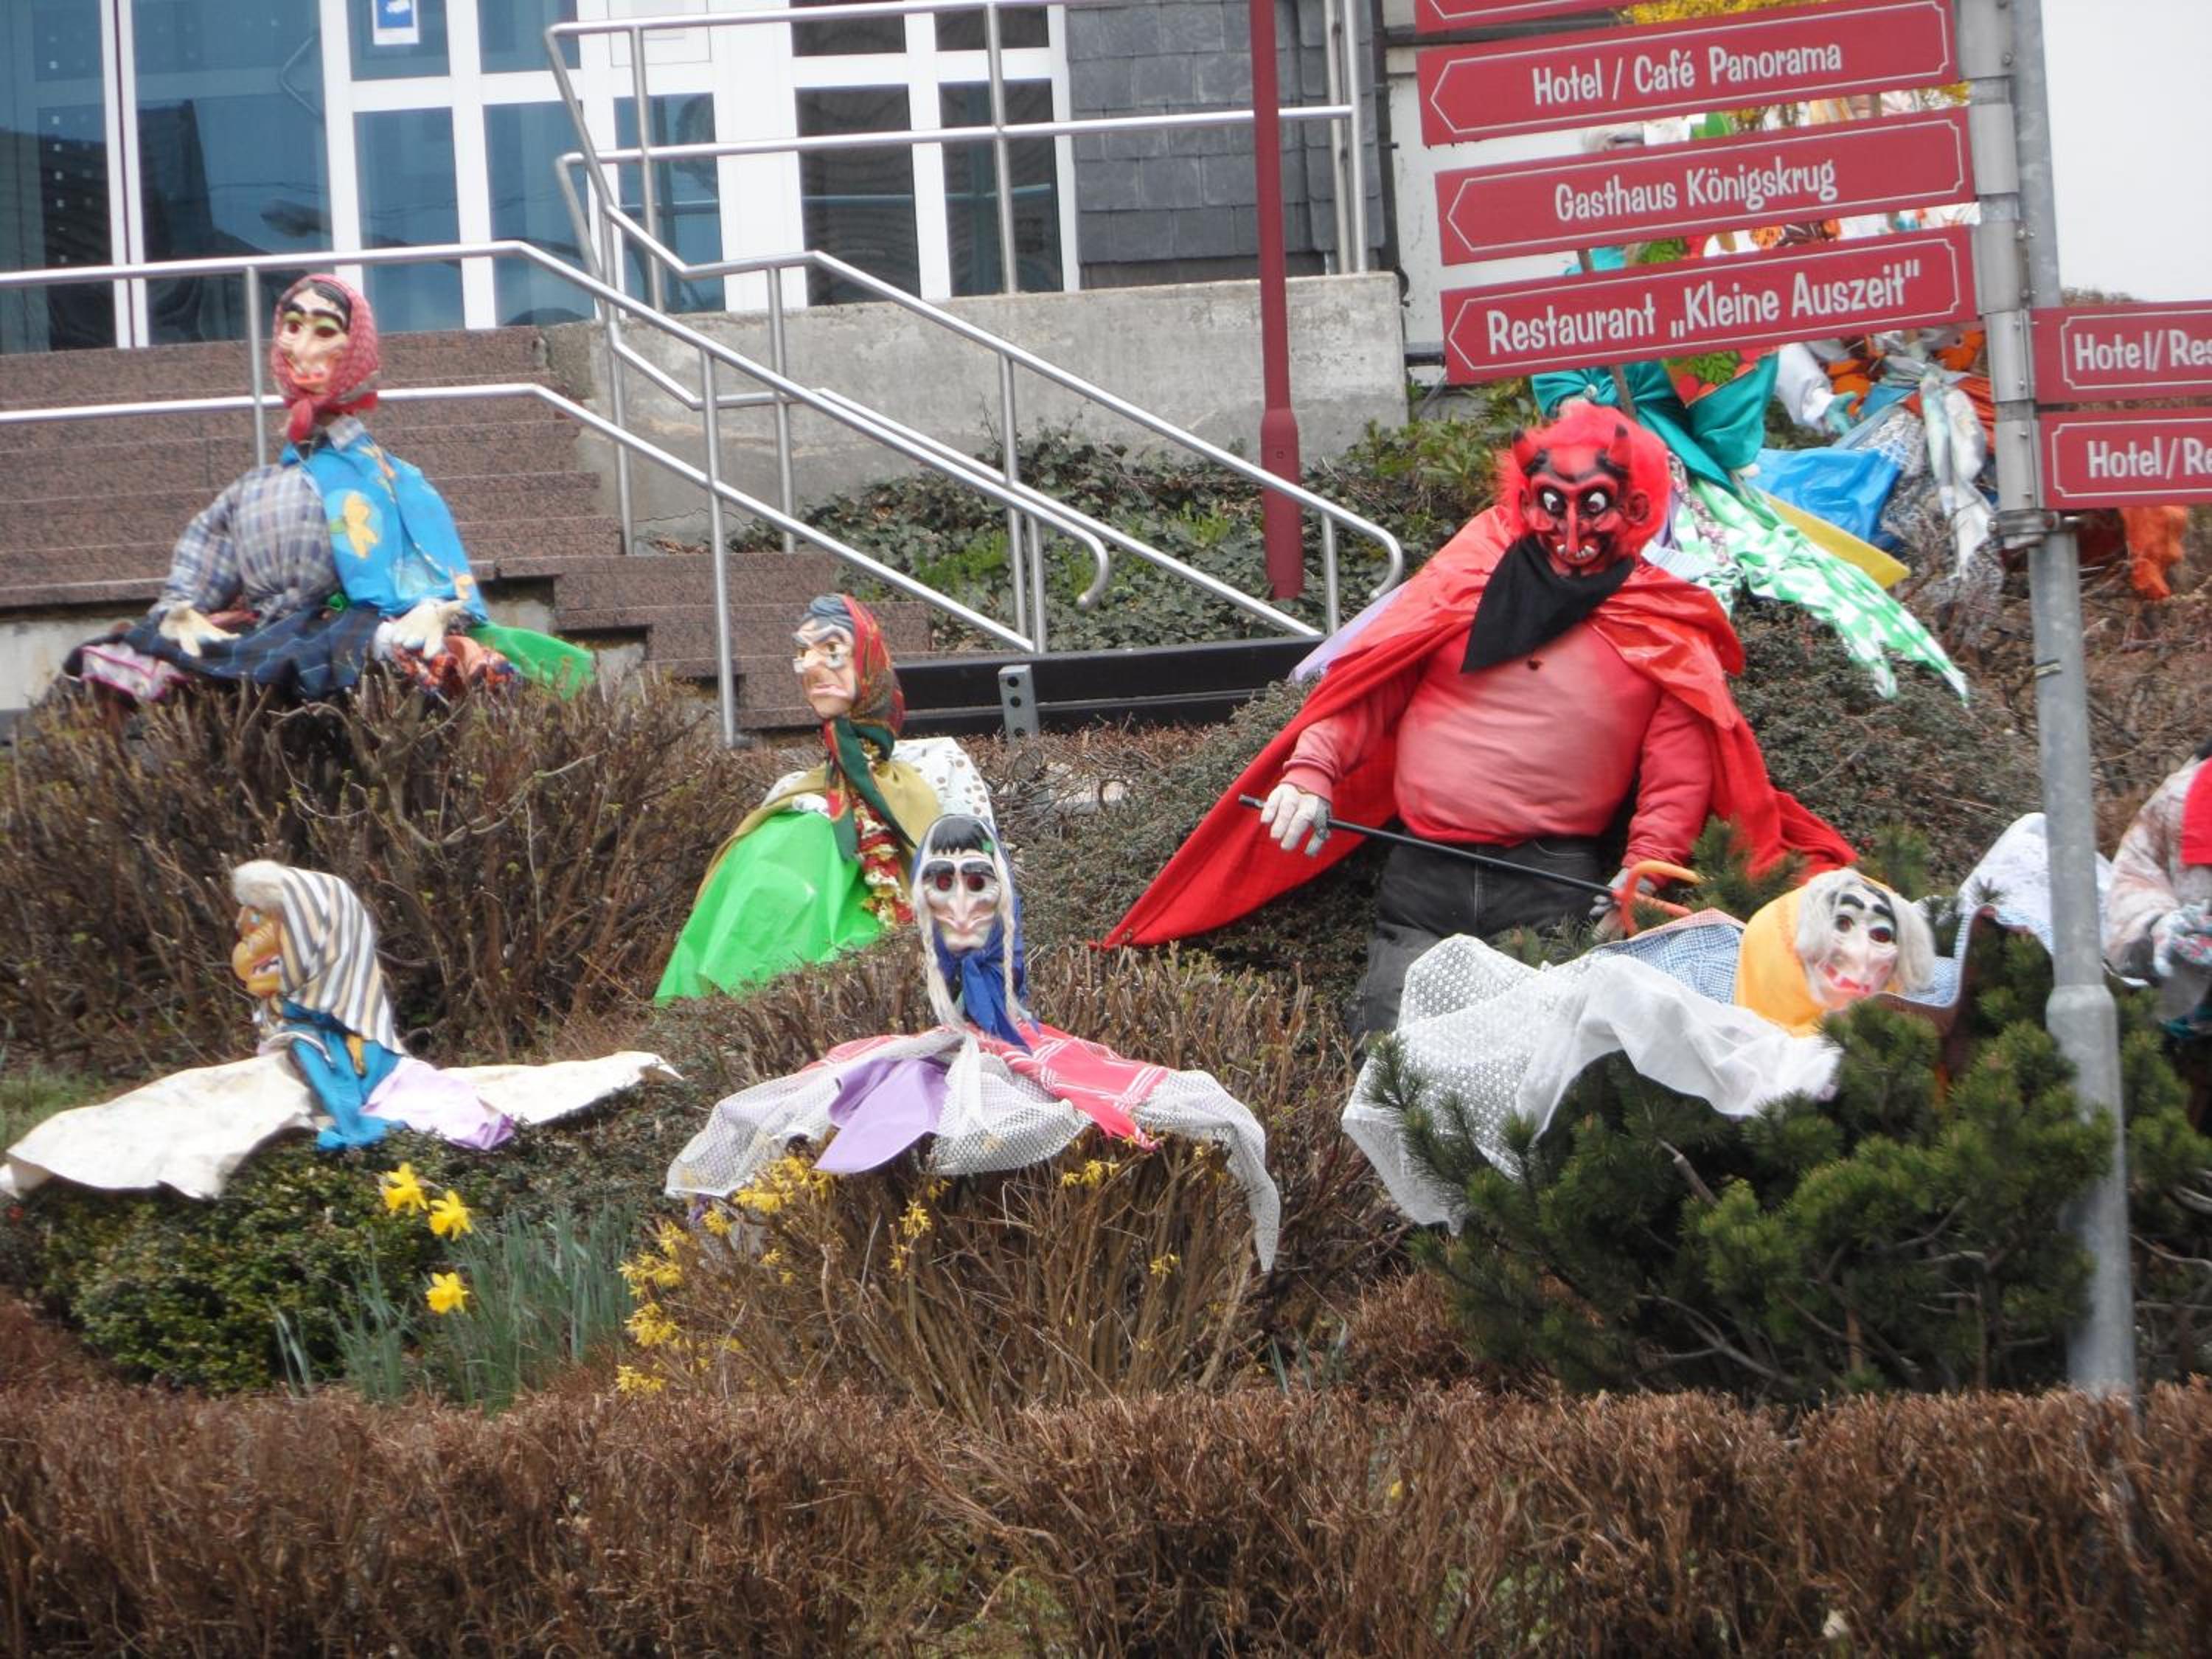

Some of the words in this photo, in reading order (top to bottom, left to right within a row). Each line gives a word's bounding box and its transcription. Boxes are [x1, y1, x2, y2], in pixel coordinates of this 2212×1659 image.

[1532, 58, 1603, 105] Hotel
[1613, 58, 1623, 101] /
[1633, 49, 1695, 94] Café
[1708, 44, 1842, 85] Panorama
[1554, 174, 1677, 222] Gasthaus
[1686, 156, 1837, 212] Königskrug
[1486, 293, 1656, 355] Restaurant
